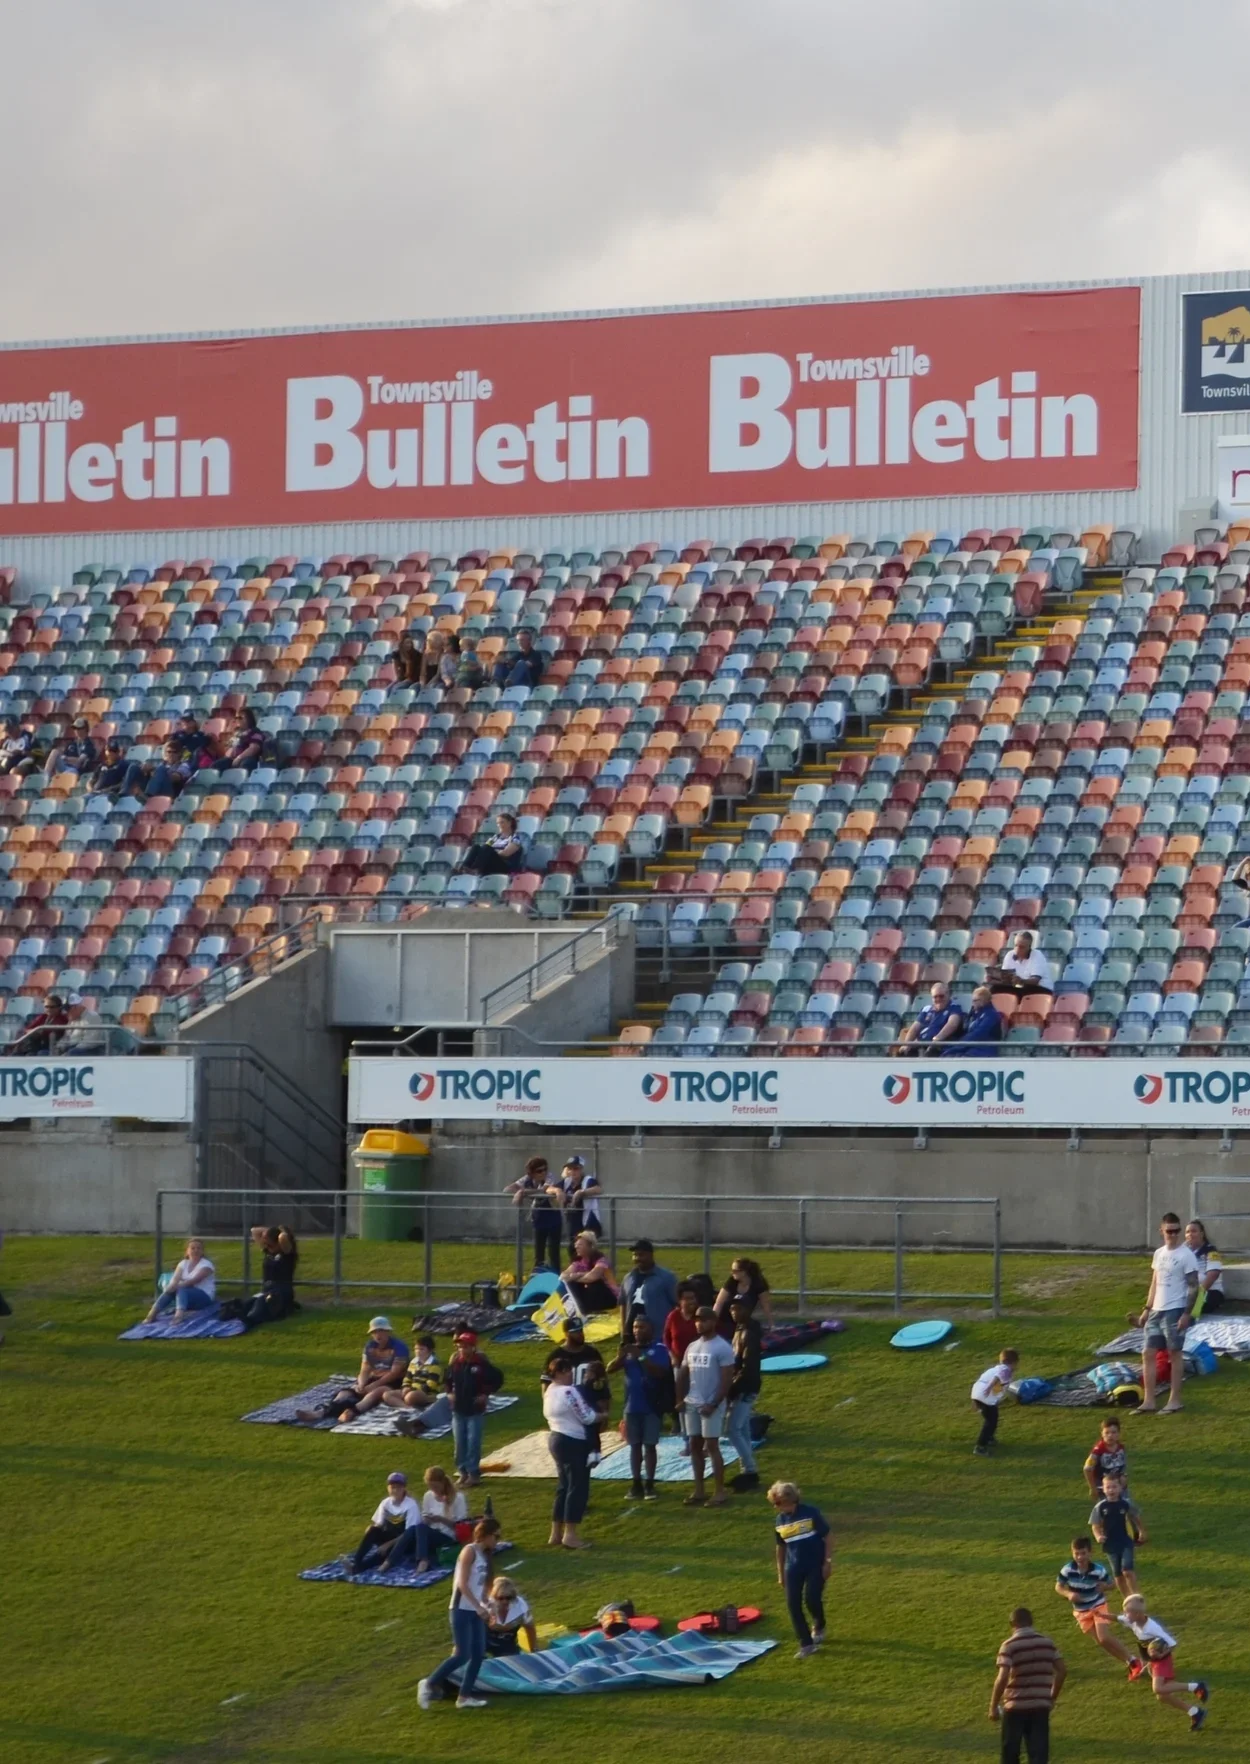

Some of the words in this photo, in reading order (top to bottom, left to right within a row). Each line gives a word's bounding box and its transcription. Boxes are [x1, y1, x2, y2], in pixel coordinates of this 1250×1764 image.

[796, 345, 931, 382] Townsville
[367, 370, 493, 404] Townsville
[709, 352, 1098, 473] Bulletin
[286, 375, 650, 492] Bulletin
[0, 416, 230, 504] lletin
[0, 1067, 93, 1097] TROPIC
[437, 1069, 540, 1100] TROPIC
[670, 1071, 777, 1102] TROPIC
[913, 1070, 1024, 1102] TROPIC
[497, 1103, 540, 1112] Petroleum
[732, 1105, 778, 1114] Petroleum
[977, 1106, 1024, 1115] Petroleum
